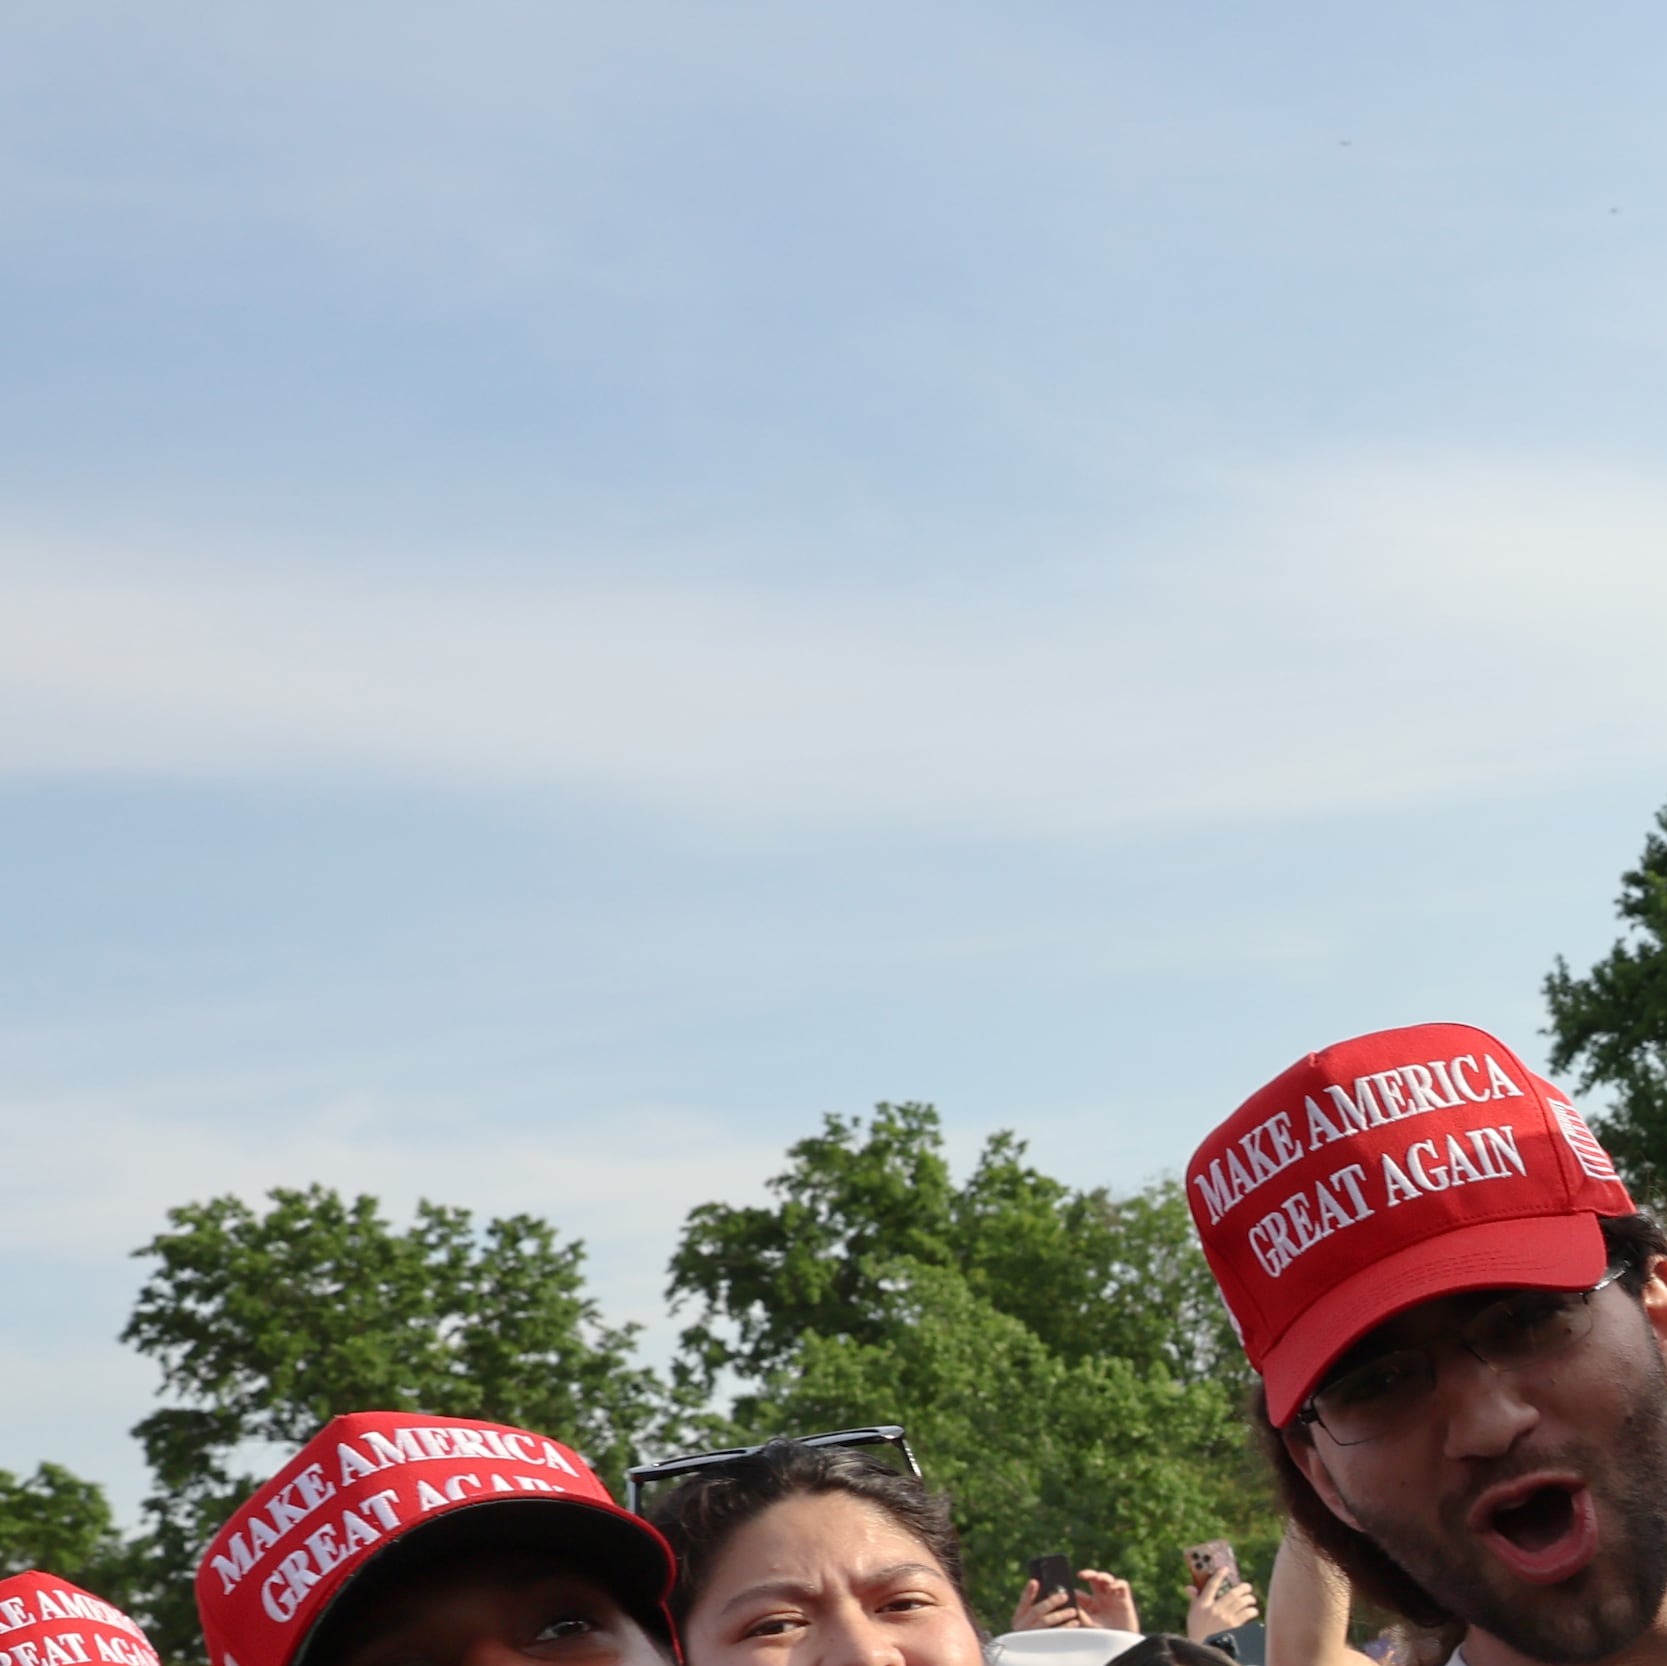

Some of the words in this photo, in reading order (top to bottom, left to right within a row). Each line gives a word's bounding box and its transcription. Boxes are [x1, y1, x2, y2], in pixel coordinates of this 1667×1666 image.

[1194, 1111, 1304, 1226] MAKE
[1305, 1054, 1523, 1149] AMERICA
[1249, 1164, 1374, 1277] GREAT
[1382, 1125, 1526, 1207] AGAIN
[211, 1463, 336, 1596] MAKE
[337, 1427, 579, 1487] AMERICA
[262, 1490, 400, 1623] GREAT
